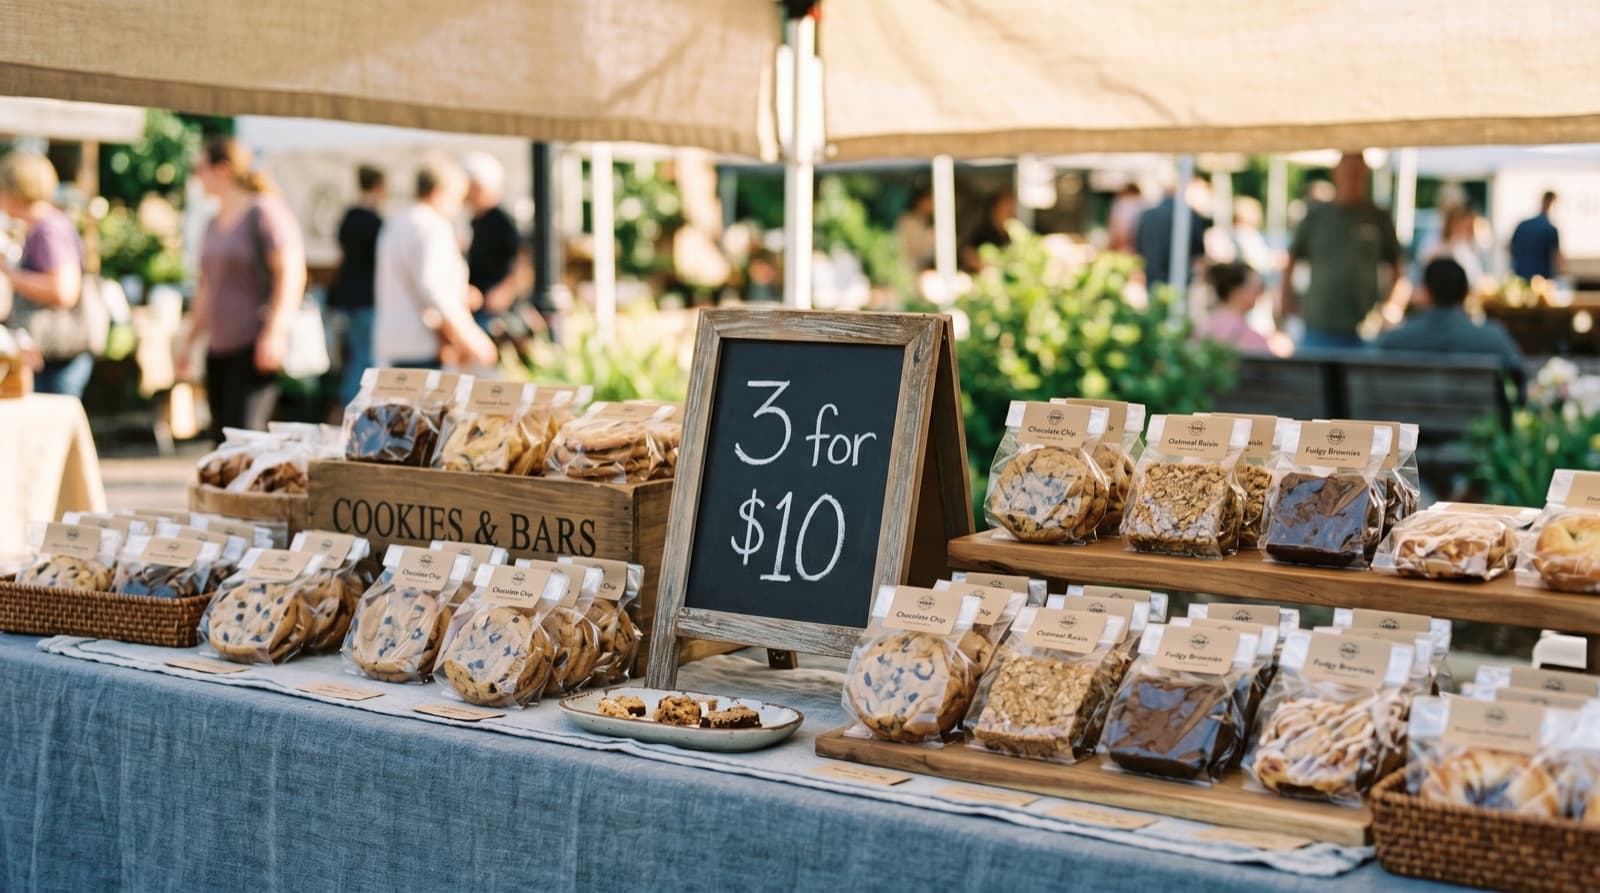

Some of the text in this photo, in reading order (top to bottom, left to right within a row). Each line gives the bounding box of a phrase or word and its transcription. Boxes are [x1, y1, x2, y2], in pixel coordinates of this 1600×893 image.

[734, 380, 877, 467] 3 for
[1028, 425, 1076, 438] Chocolate Chip
[1168, 438, 1219, 448] Oatmeal Raisin
[1305, 446, 1360, 456] Fudgy Brownies
[333, 498, 597, 558] COOKIES & BARS
[731, 489, 846, 581] $10
[402, 568, 441, 580] Chocolate Chip
[492, 586, 534, 598] Chocolate Chip
[896, 611, 928, 621] Chocolate
[930, 616, 946, 624] Chip
[1036, 630, 1066, 638] Oatmeal
[1067, 634, 1088, 642] Raisin
